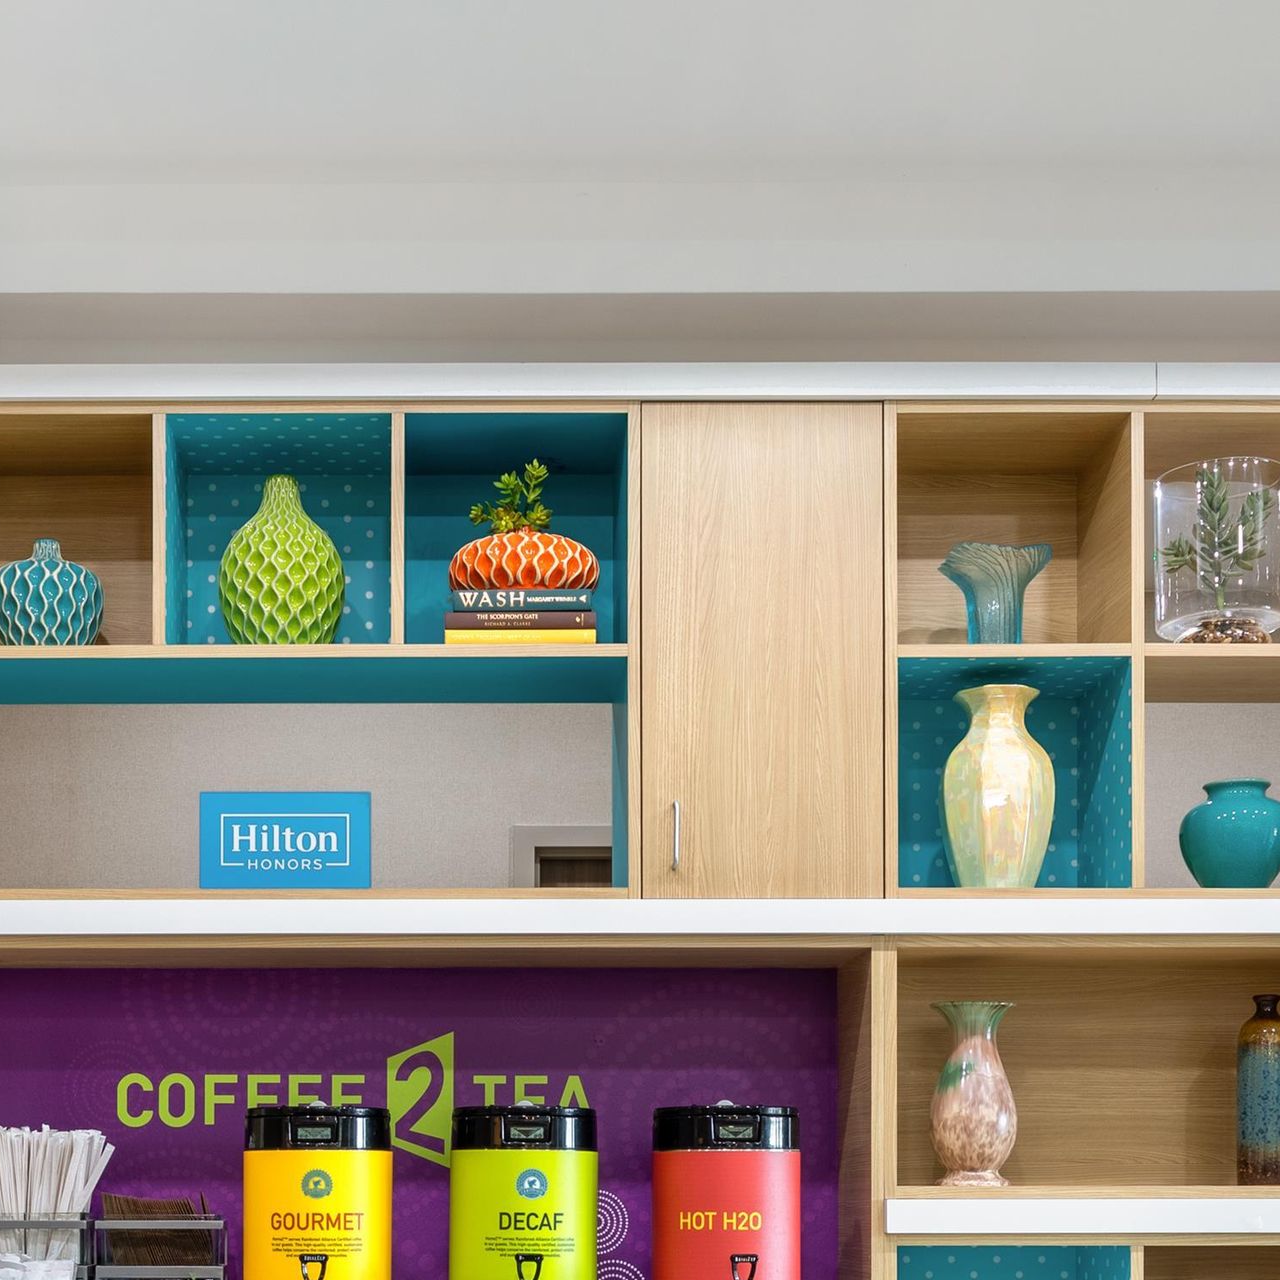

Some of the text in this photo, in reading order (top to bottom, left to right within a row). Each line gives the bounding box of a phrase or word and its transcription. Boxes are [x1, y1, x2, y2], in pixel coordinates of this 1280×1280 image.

[459, 591, 525, 607] WASH
[231, 823, 339, 853] Hilton
[247, 858, 323, 871] HONORS
[472, 1074, 591, 1109] TEA
[270, 1212, 364, 1231] GOURMET
[498, 1212, 564, 1231] DECAF
[679, 1211, 718, 1231] HOT
